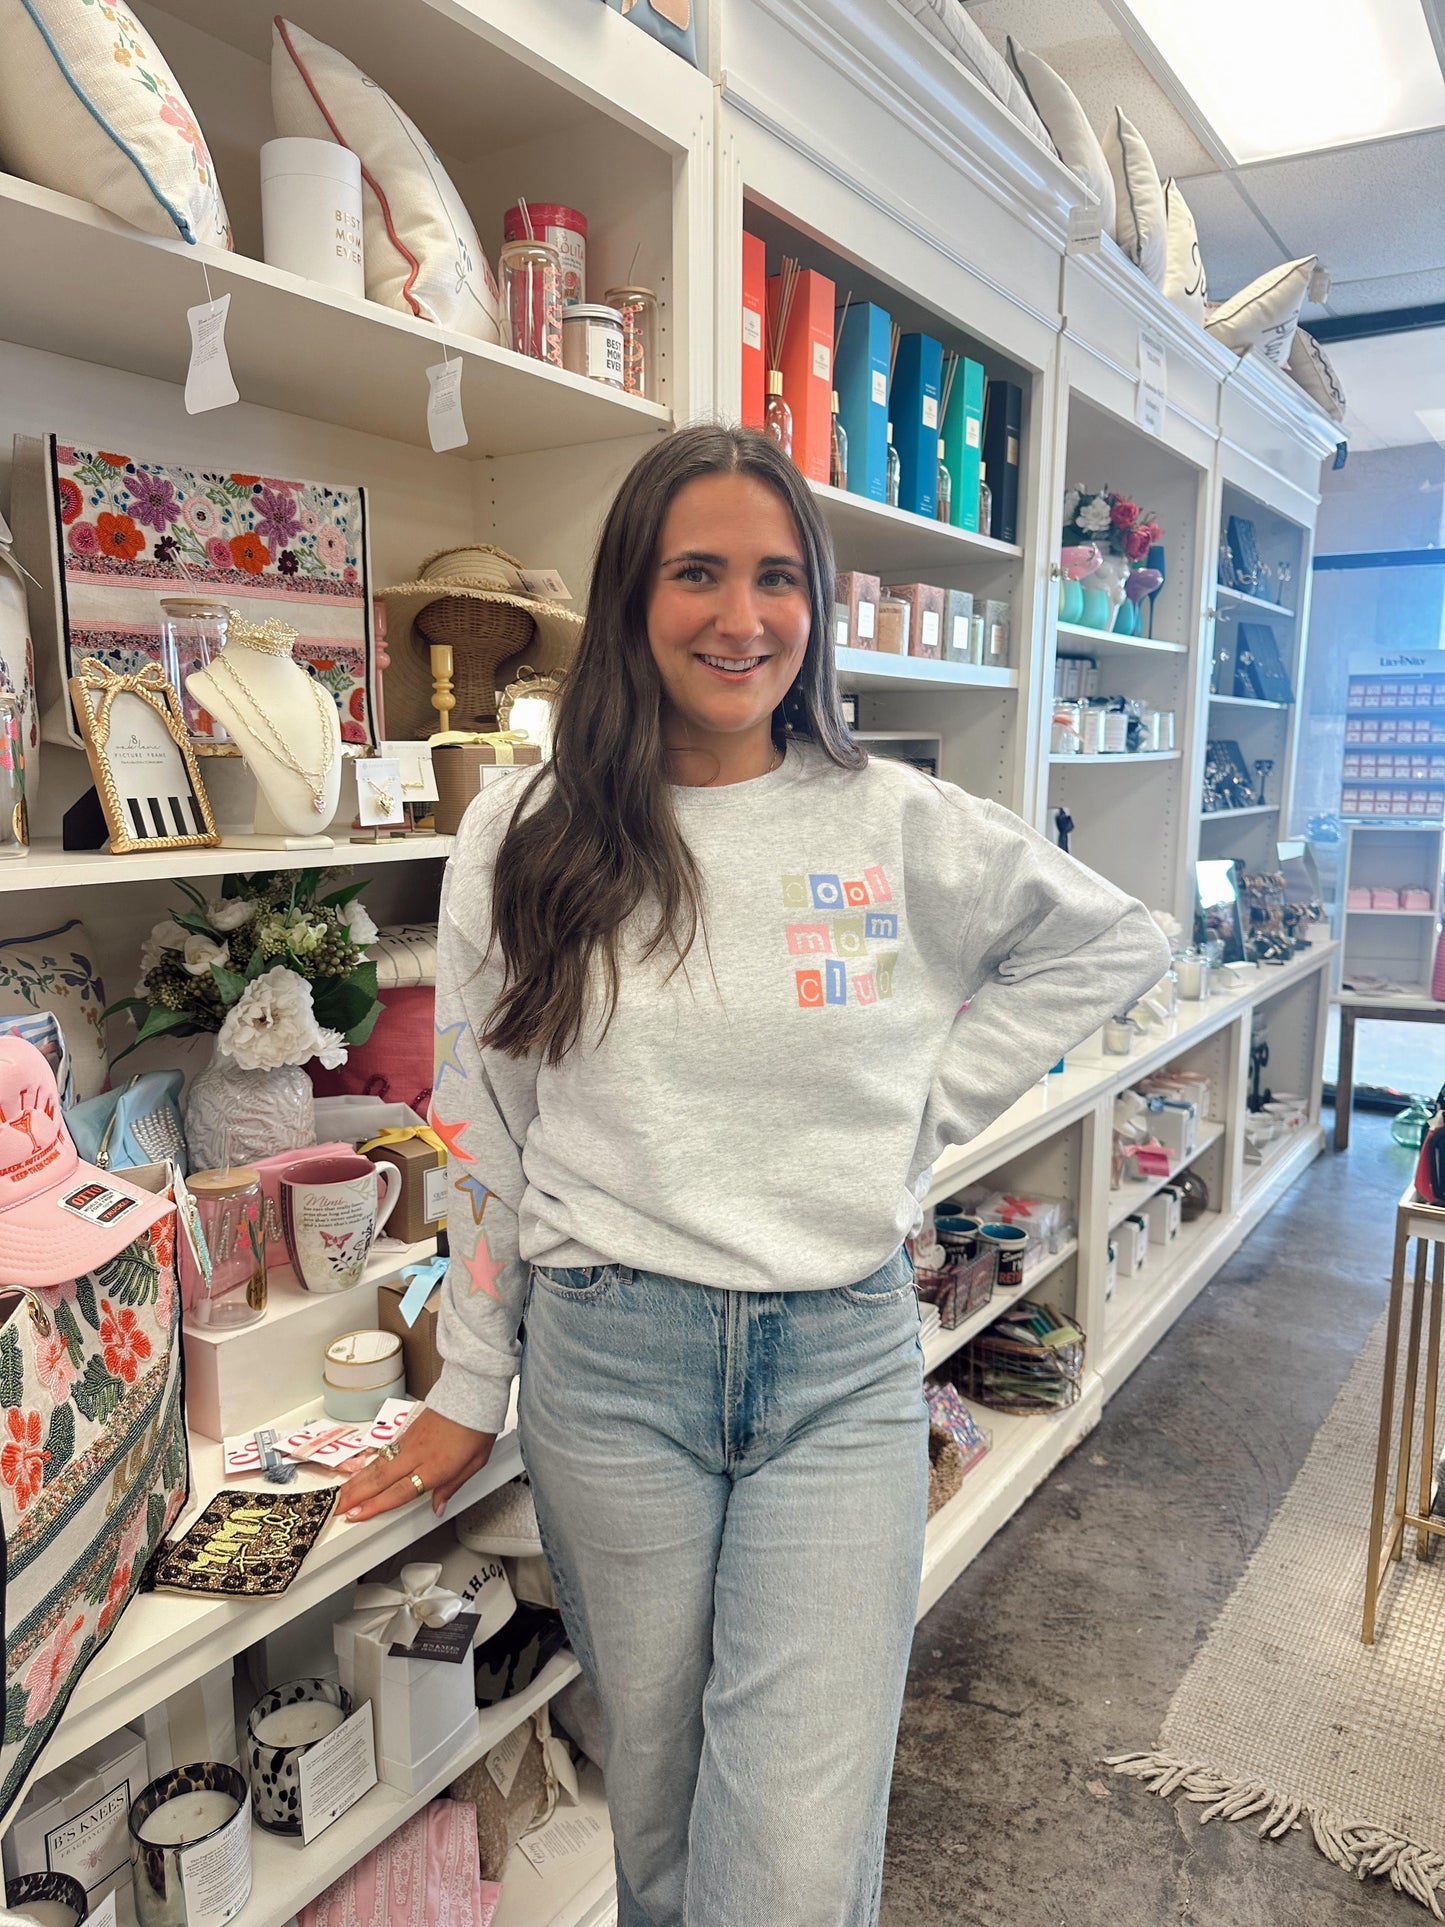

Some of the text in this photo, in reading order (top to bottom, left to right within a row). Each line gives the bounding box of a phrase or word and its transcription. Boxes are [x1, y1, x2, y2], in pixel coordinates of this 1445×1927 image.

[335, 209, 360, 230] BEST
[335, 228, 361, 250] MOM
[335, 245, 362, 266] EVER
[560, 242, 584, 259] OLITA
[606, 338, 622, 350] BEST
[606, 350, 622, 362] MOM
[606, 360, 622, 373] EVER
[792, 916, 893, 952] mom
[71, 1186, 104, 1206] OTTO
[303, 1193, 347, 1208] Mimi
[462, 1563, 506, 1602] MOTHE
[54, 1793, 125, 1850] B'S KNEES
